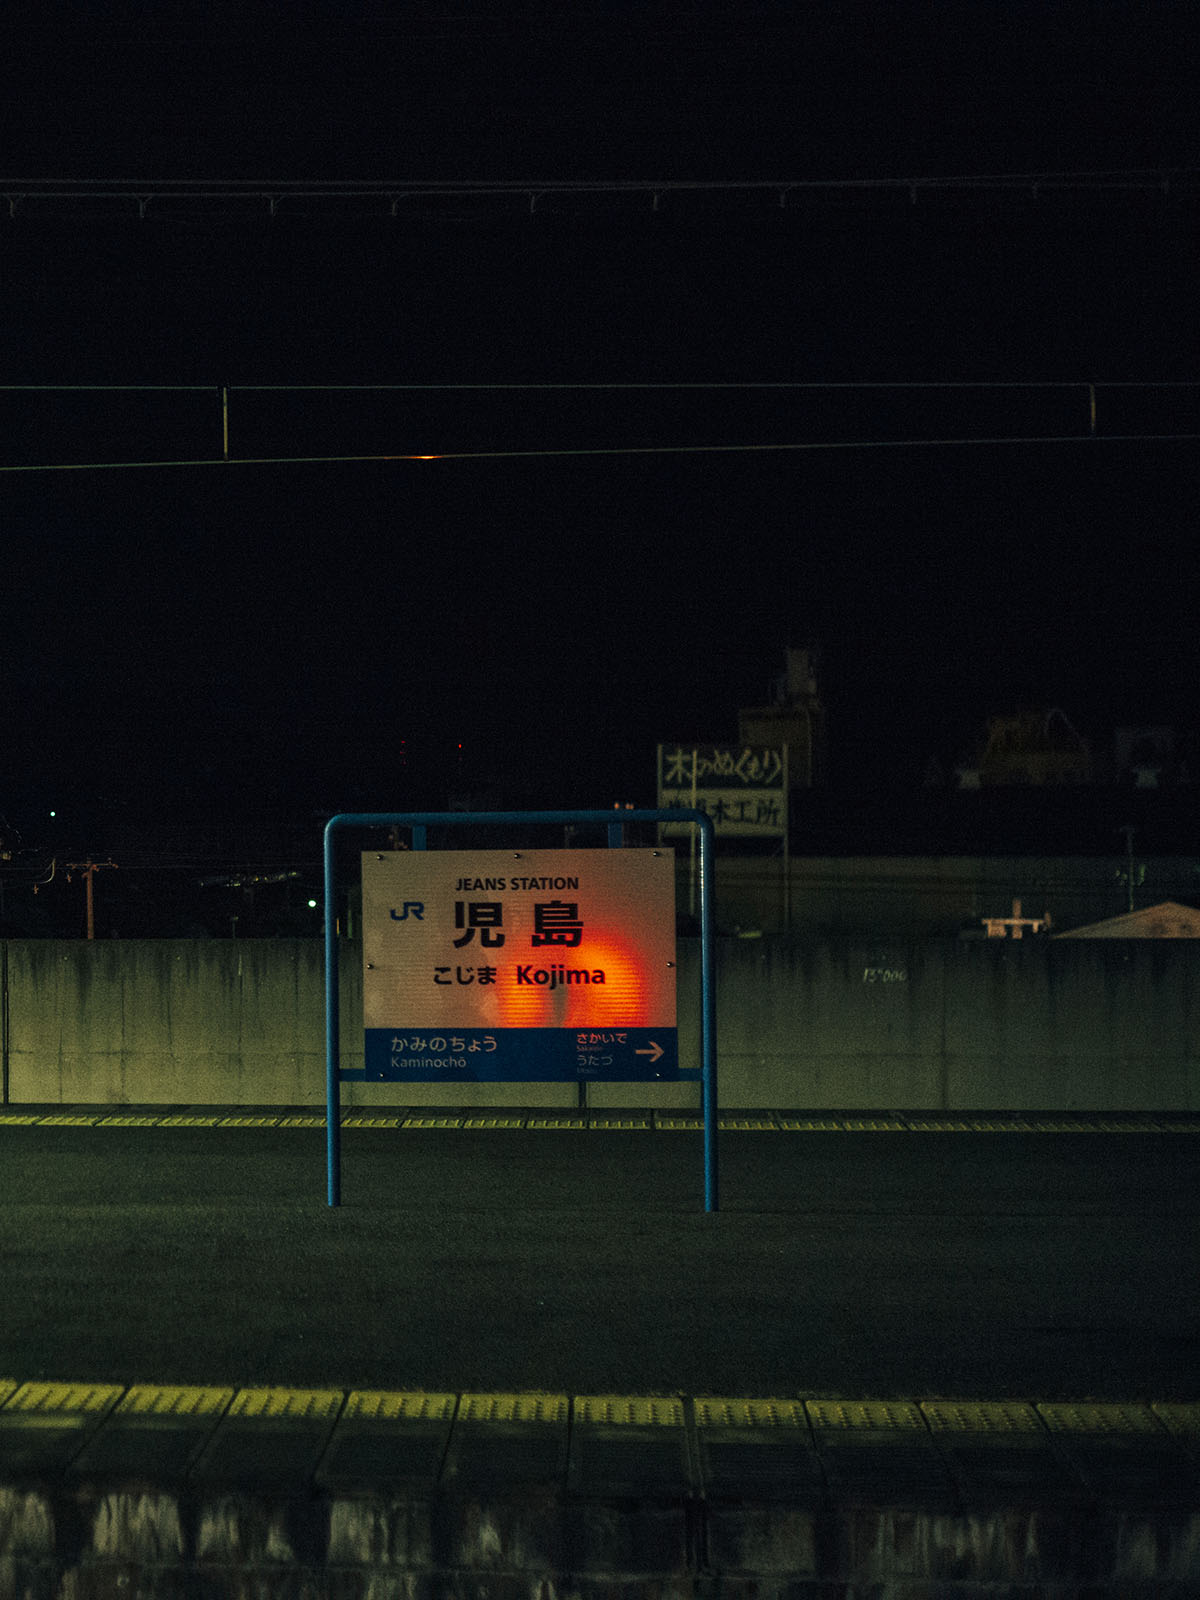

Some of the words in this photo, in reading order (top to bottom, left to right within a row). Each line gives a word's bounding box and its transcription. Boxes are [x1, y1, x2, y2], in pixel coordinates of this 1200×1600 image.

[455, 878, 506, 891] JEANS
[510, 877, 579, 891] STATION
[390, 902, 425, 921] JR
[453, 901, 584, 949] 児島
[433, 966, 497, 985] こじま
[516, 965, 606, 990] Kojima
[391, 1035, 498, 1053] かみのちょう
[576, 1032, 628, 1045] さかいで
